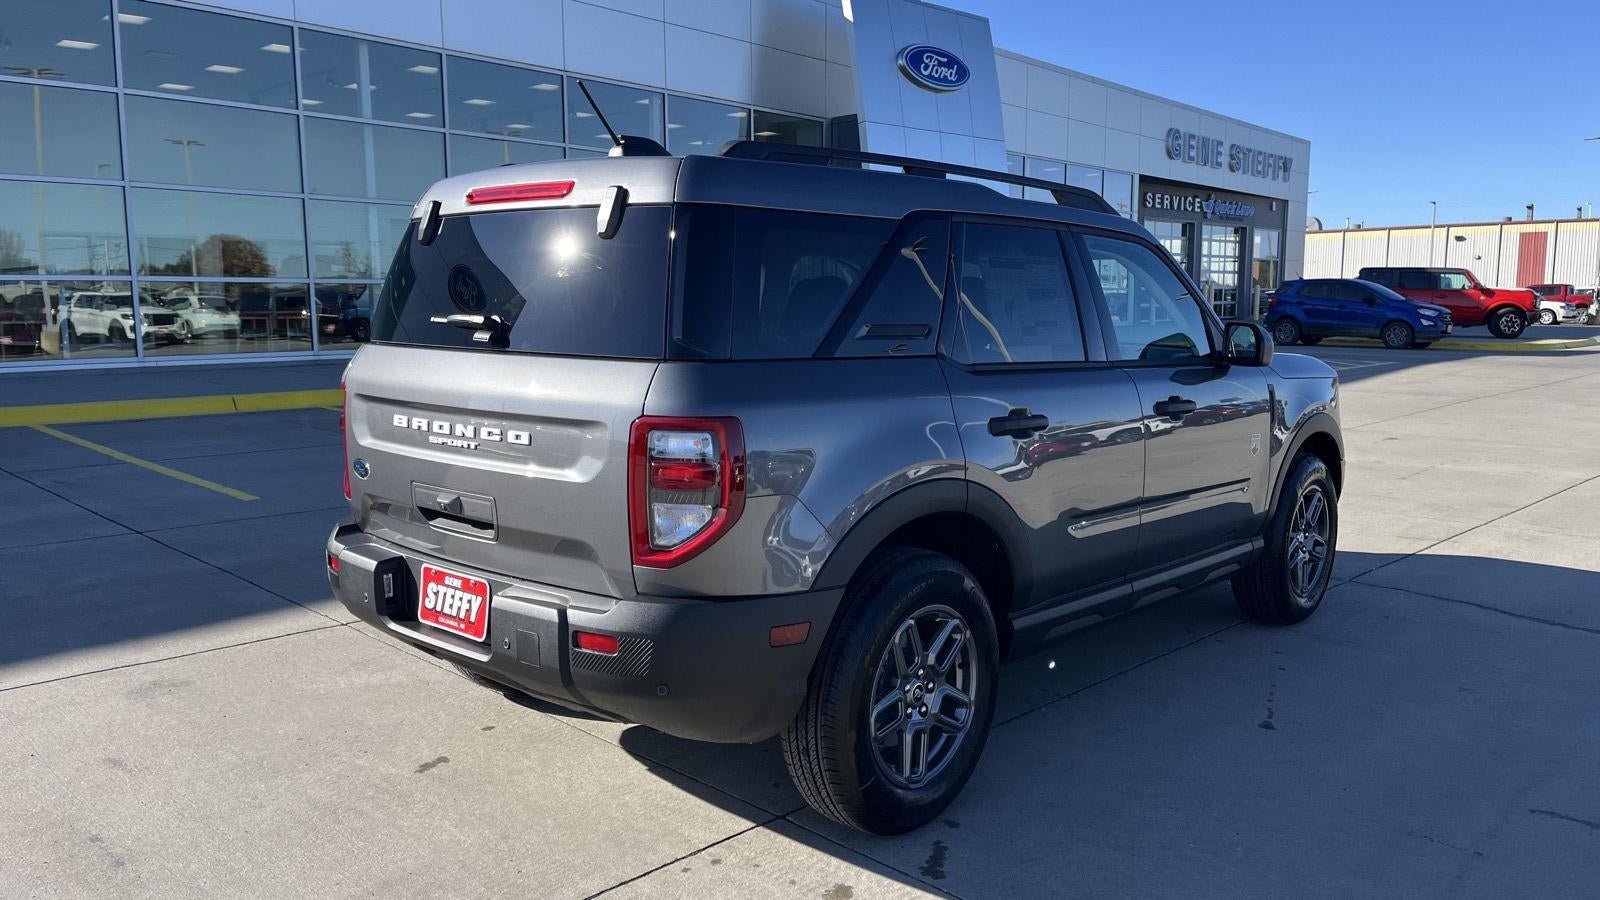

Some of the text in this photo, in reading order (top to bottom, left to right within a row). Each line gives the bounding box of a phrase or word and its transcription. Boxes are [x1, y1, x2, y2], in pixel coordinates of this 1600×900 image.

[920, 53, 958, 81] Ford
[1166, 127, 1294, 182] GENE STEFFY
[1146, 192, 1201, 212] SERVICE
[392, 414, 531, 446] BRONCO
[428, 435, 480, 450] SPORT
[444, 575, 463, 588] GENE
[424, 582, 483, 623] STEFFY
